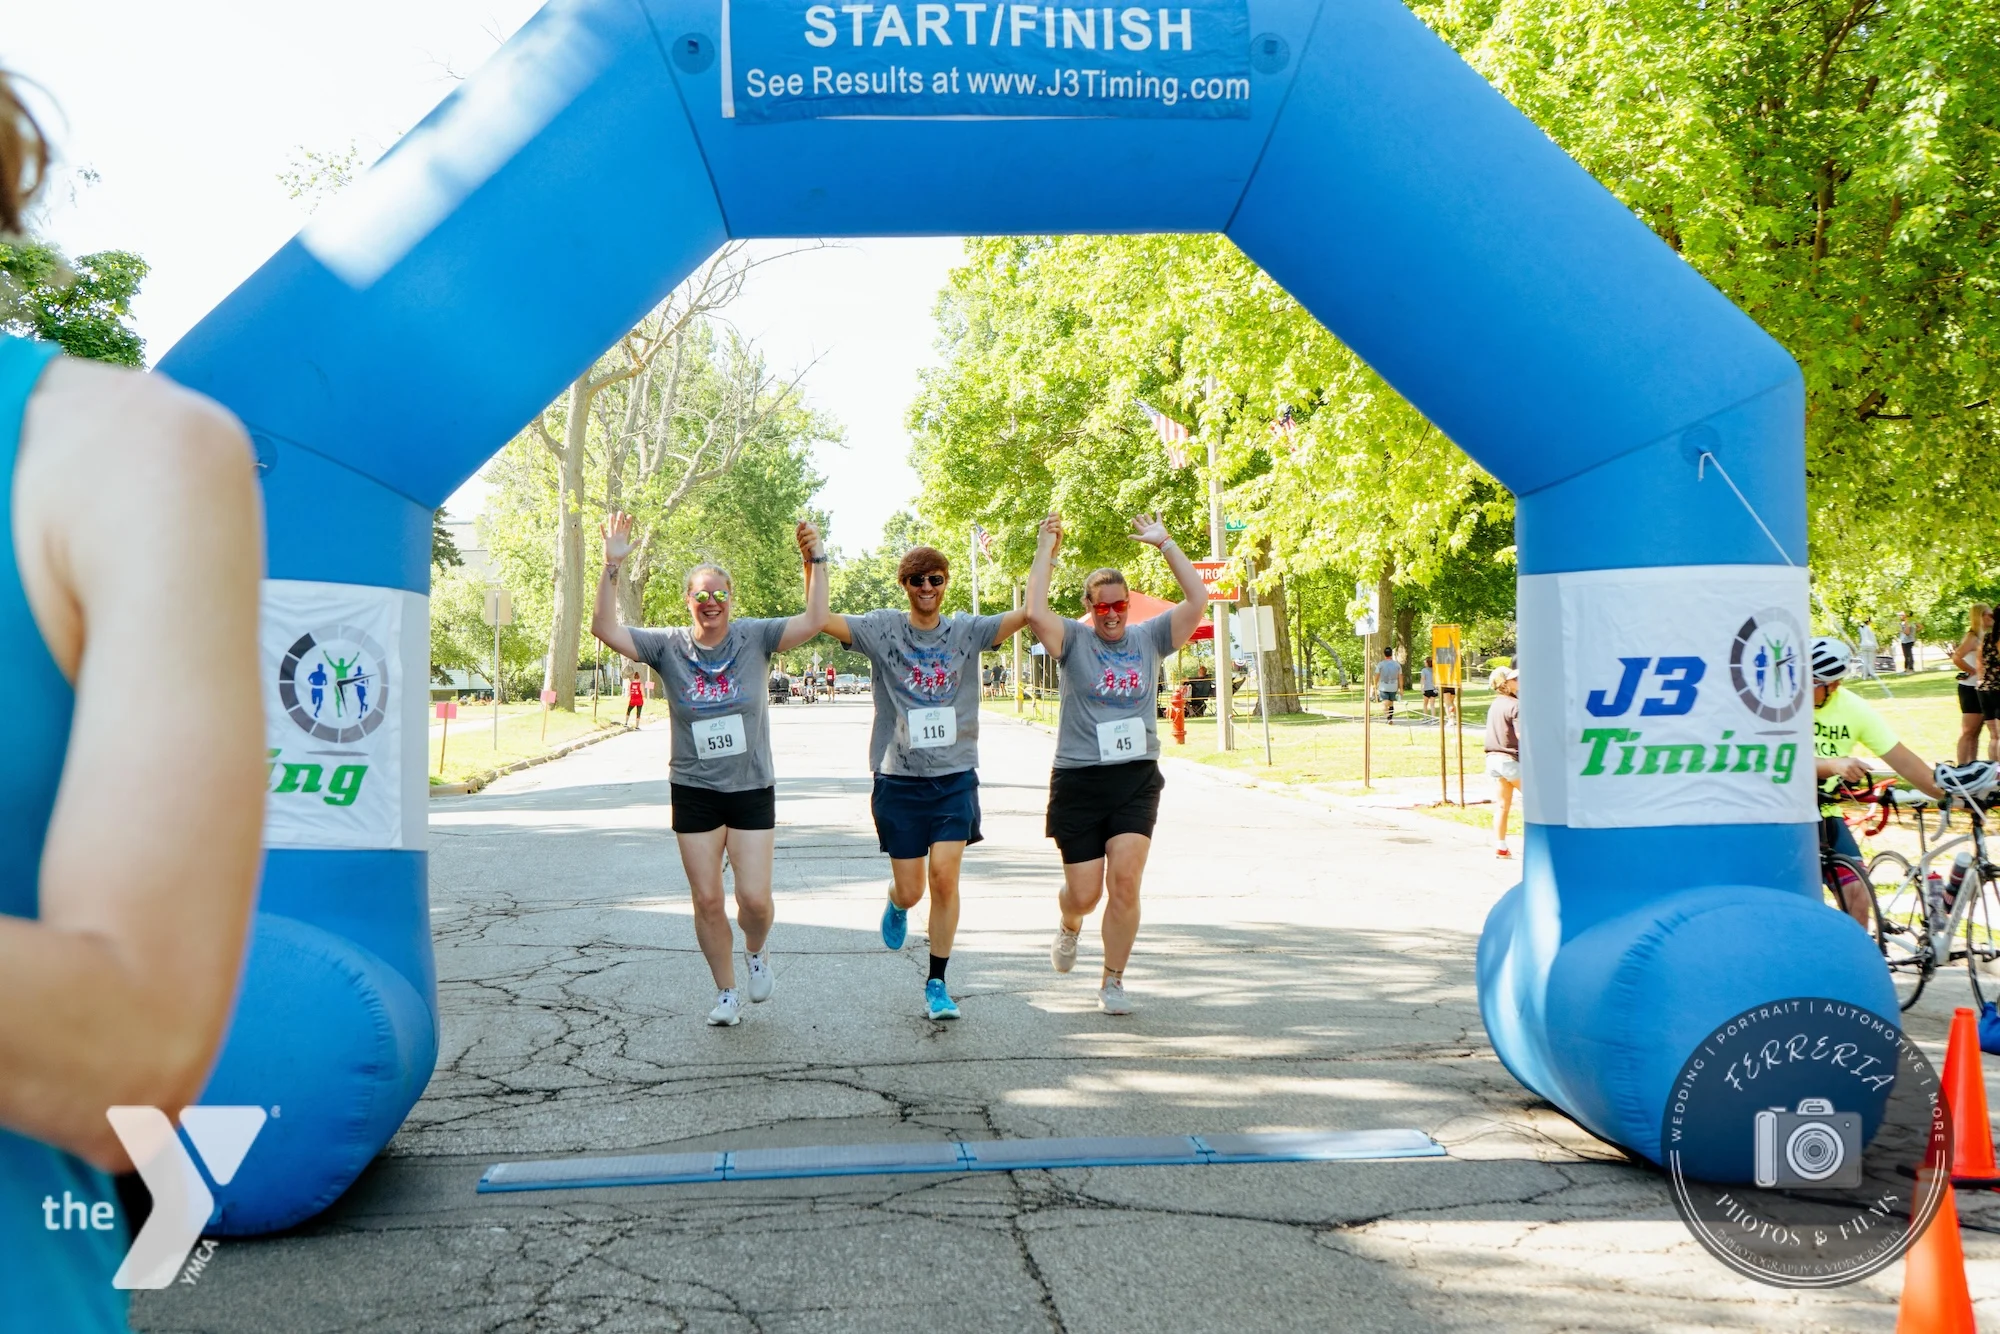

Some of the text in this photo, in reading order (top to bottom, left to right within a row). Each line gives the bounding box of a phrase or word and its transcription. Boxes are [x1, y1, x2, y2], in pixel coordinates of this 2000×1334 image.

[804, 2, 1193, 52] START/FINISH
[746, 66, 1251, 106] See Results at www.J3Timing.com
[1585, 656, 1707, 718] J3
[708, 733, 733, 751] 539
[923, 725, 945, 739] 116
[1116, 737, 1132, 751] 45
[1579, 727, 1798, 784] Timing
